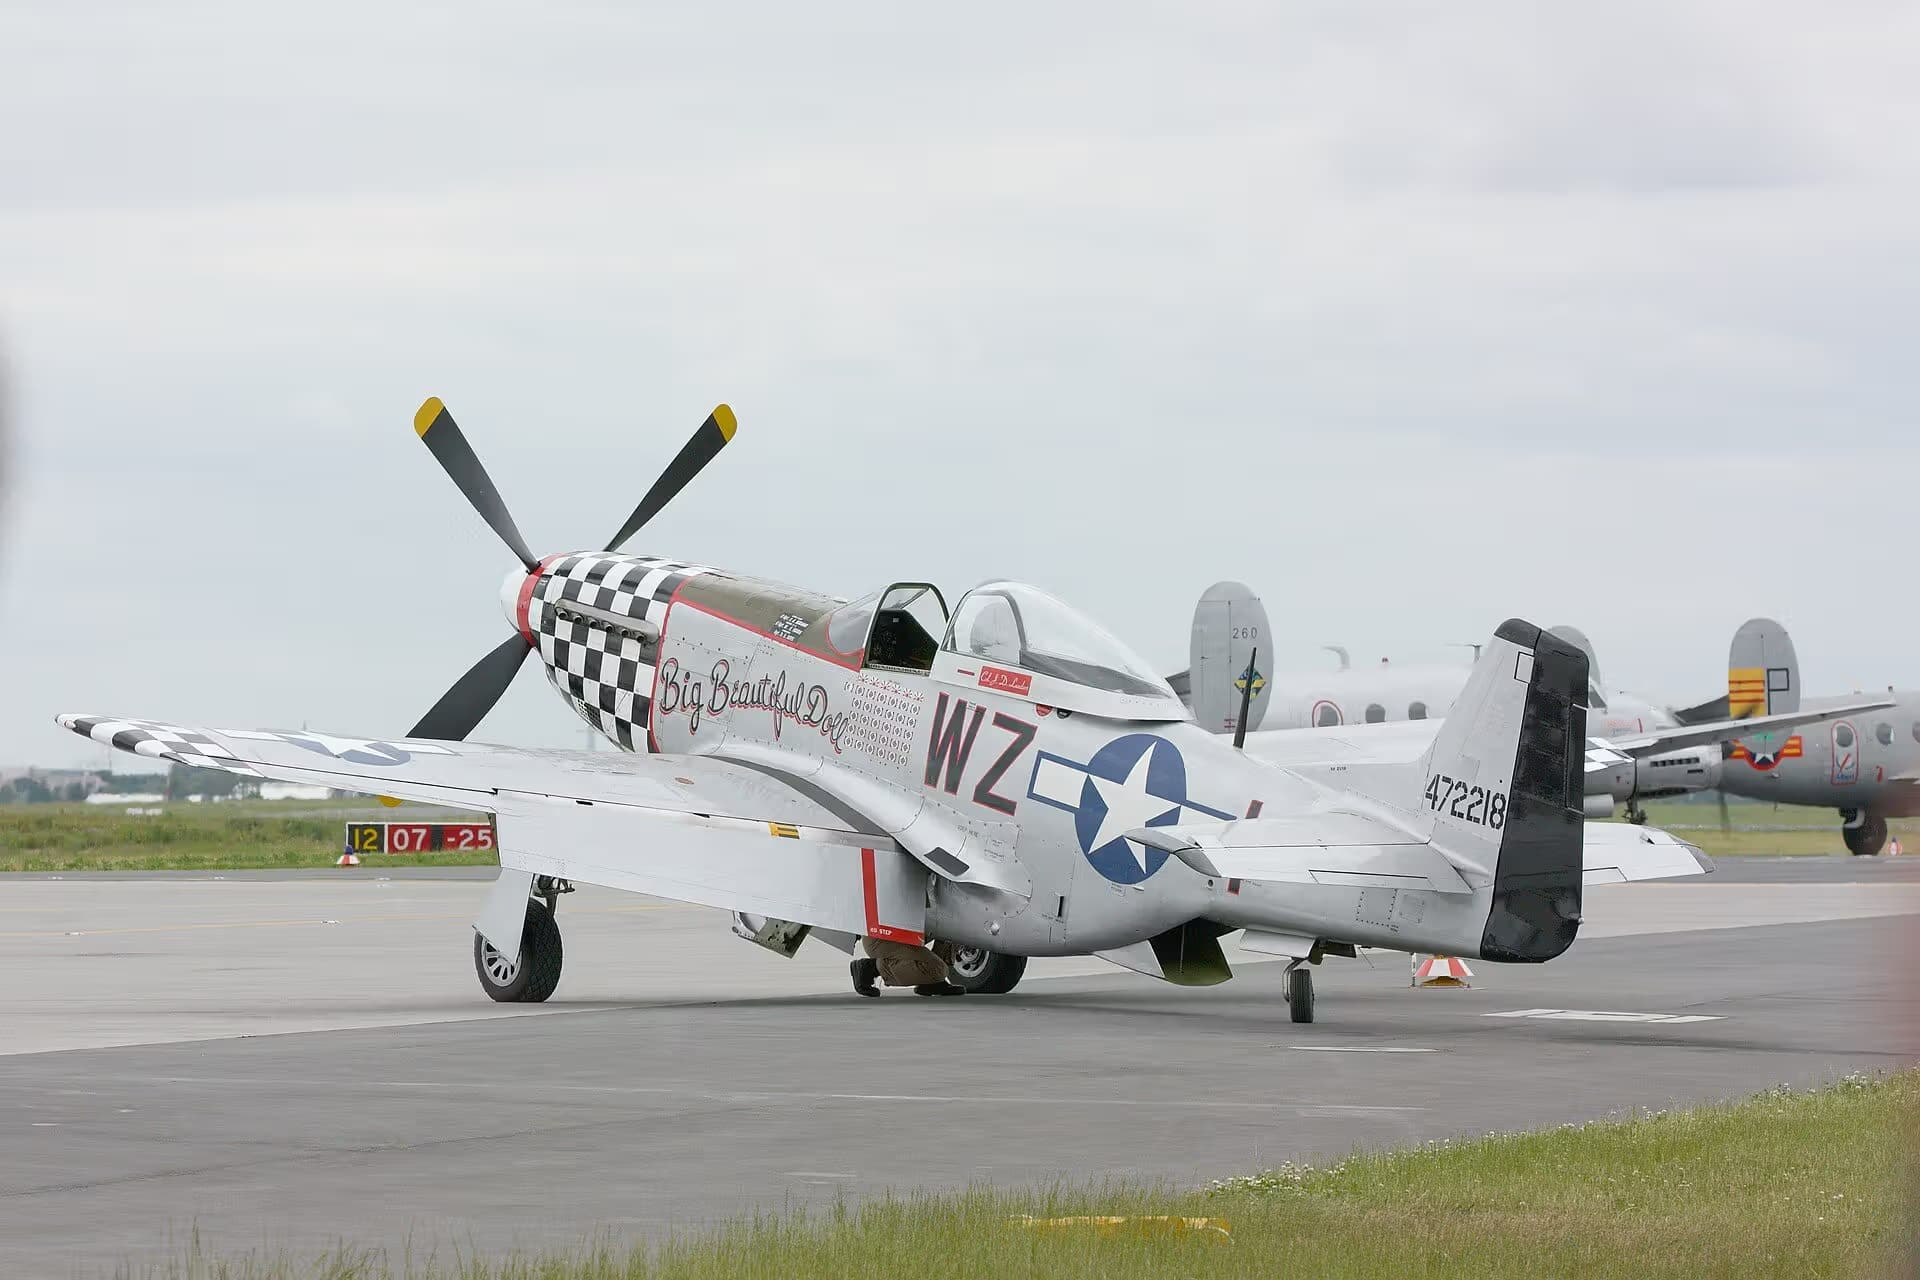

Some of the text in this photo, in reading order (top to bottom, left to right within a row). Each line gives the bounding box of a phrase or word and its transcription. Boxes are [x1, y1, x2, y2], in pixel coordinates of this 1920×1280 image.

[1232, 627, 1258, 639] 260
[660, 657, 848, 754] Big Beautiful Doll
[924, 691, 1038, 817] WZ
[1425, 773, 1507, 830] 472218
[354, 828, 378, 851] 12
[393, 828, 427, 851] 07
